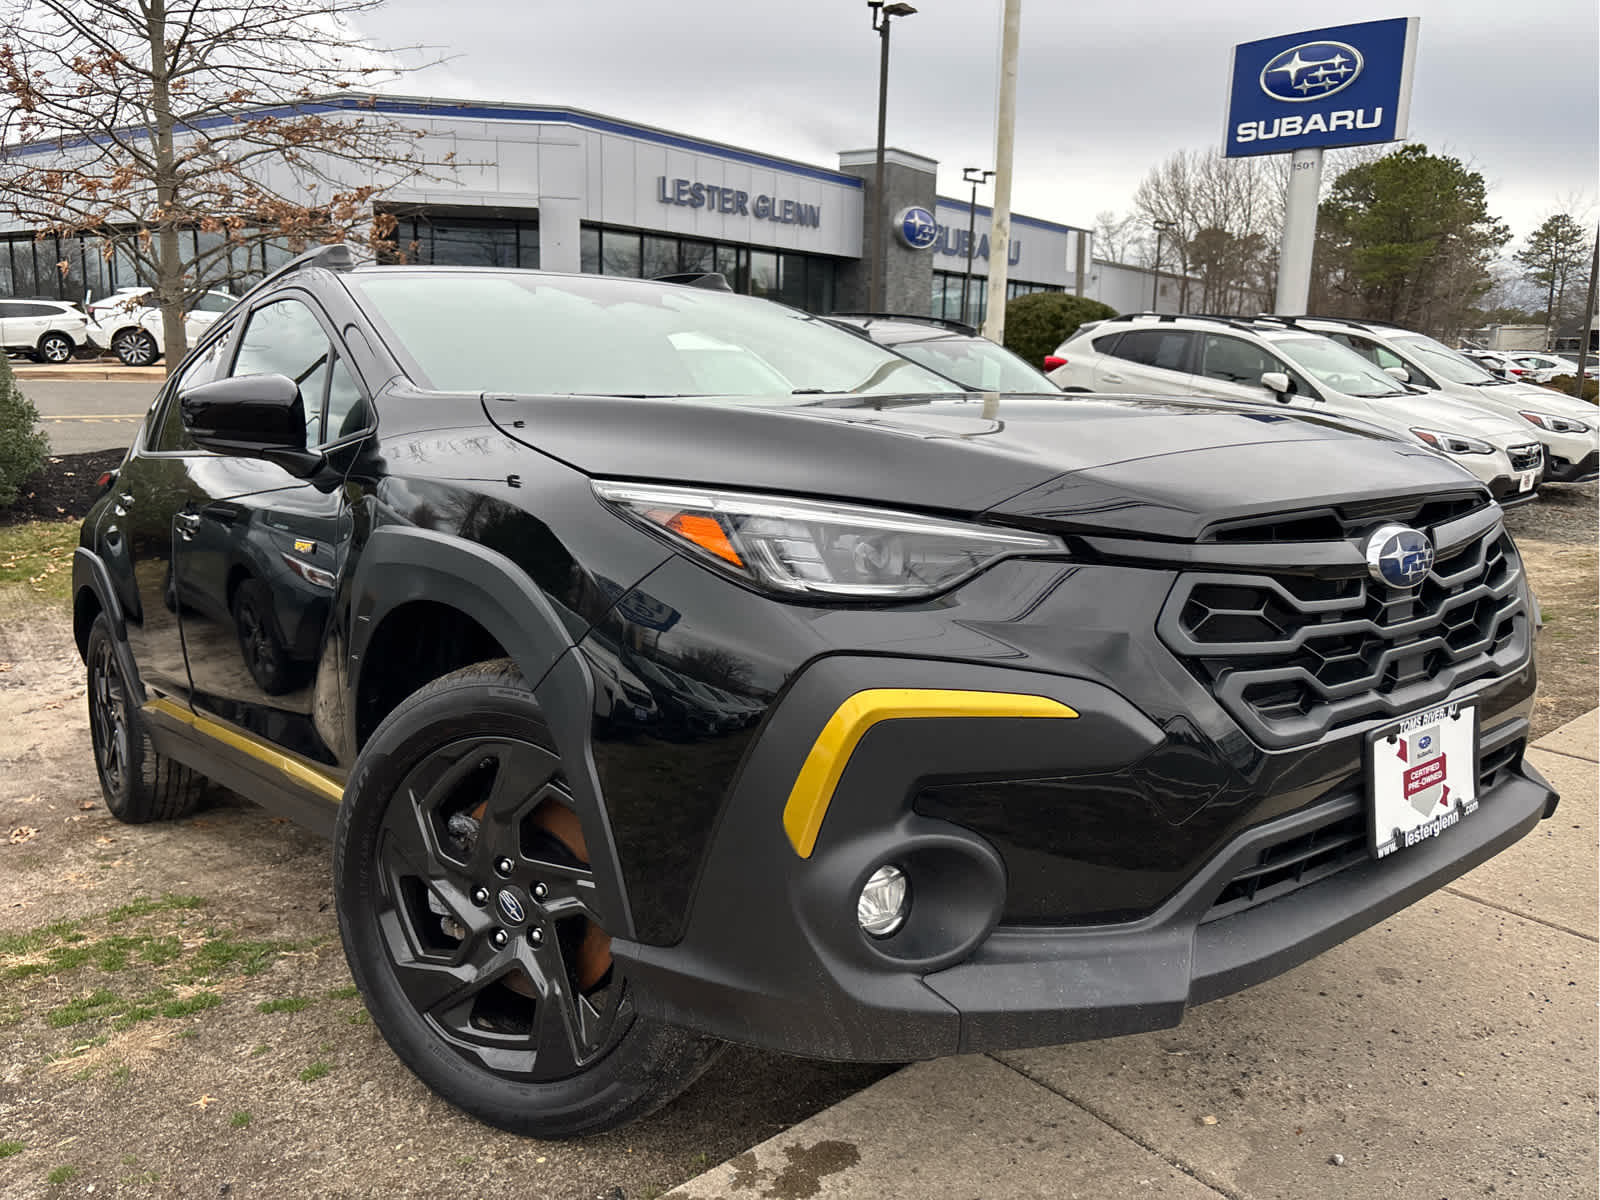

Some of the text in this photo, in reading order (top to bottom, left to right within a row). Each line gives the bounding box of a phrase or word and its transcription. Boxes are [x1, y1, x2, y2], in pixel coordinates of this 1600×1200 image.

[1236, 107, 1383, 143] SUBARU
[657, 175, 821, 229] LESTER GLENN
[932, 224, 1021, 266] SUBAU
[1400, 715, 1422, 734] TOMS
[1408, 770, 1443, 792] PRE-OWNED
[1410, 761, 1440, 780] CERTIFIED
[1404, 811, 1459, 848] lesterglenn
